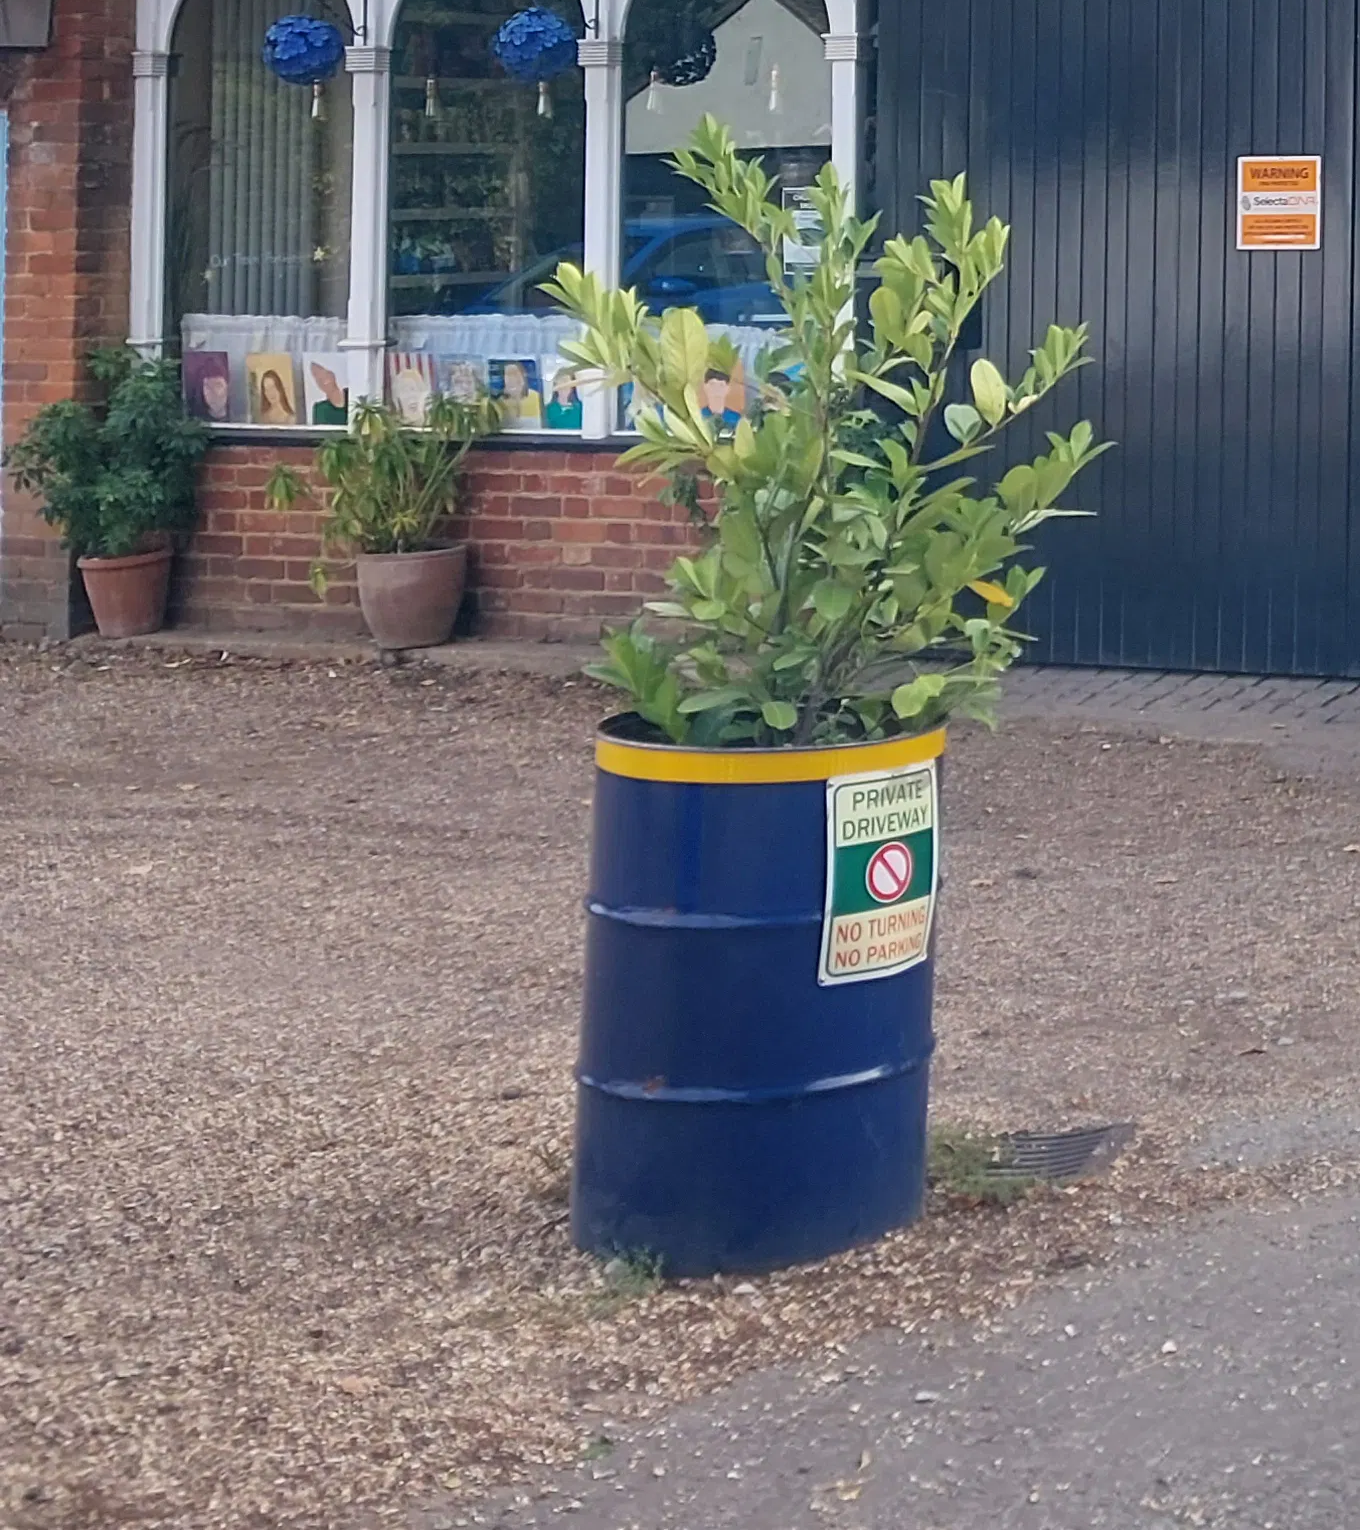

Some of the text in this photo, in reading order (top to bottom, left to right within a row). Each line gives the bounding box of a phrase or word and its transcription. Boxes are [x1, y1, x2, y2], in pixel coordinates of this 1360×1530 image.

[1250, 167, 1310, 180] WARNING
[852, 779, 924, 812] PRIVATE
[842, 804, 929, 841] DRIVEWAY
[836, 906, 926, 945] NO TURNING
[834, 933, 923, 969] NO PARKING
